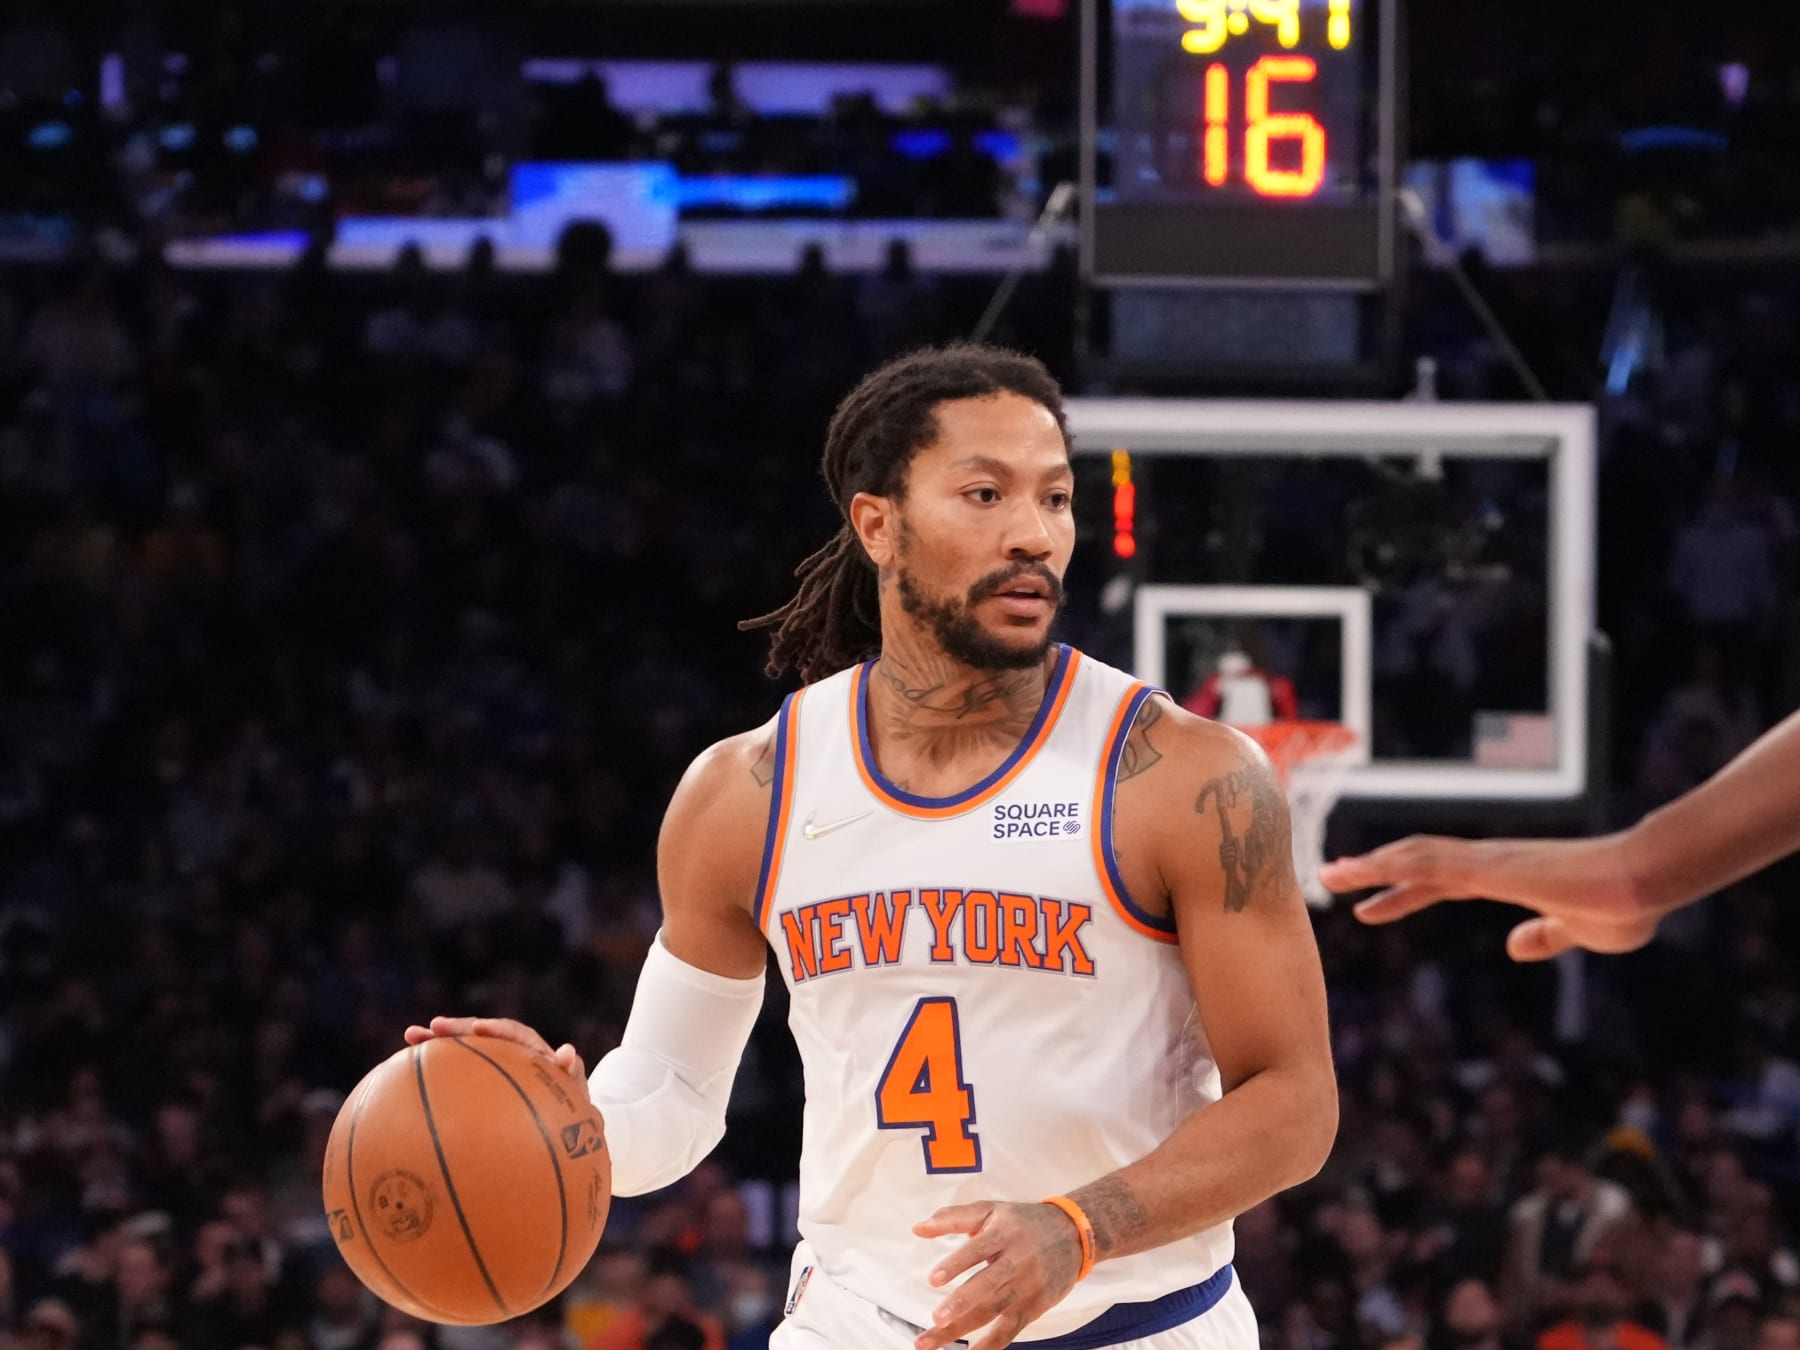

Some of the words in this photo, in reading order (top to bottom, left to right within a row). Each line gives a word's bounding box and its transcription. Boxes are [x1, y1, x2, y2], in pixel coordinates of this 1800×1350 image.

[1203, 54, 1326, 197] 16
[993, 821, 1061, 839] SPACE
[994, 803, 1079, 820] SQUARE
[780, 889, 913, 983] NEW
[917, 887, 1096, 978] YORK
[874, 996, 983, 1175] 4
